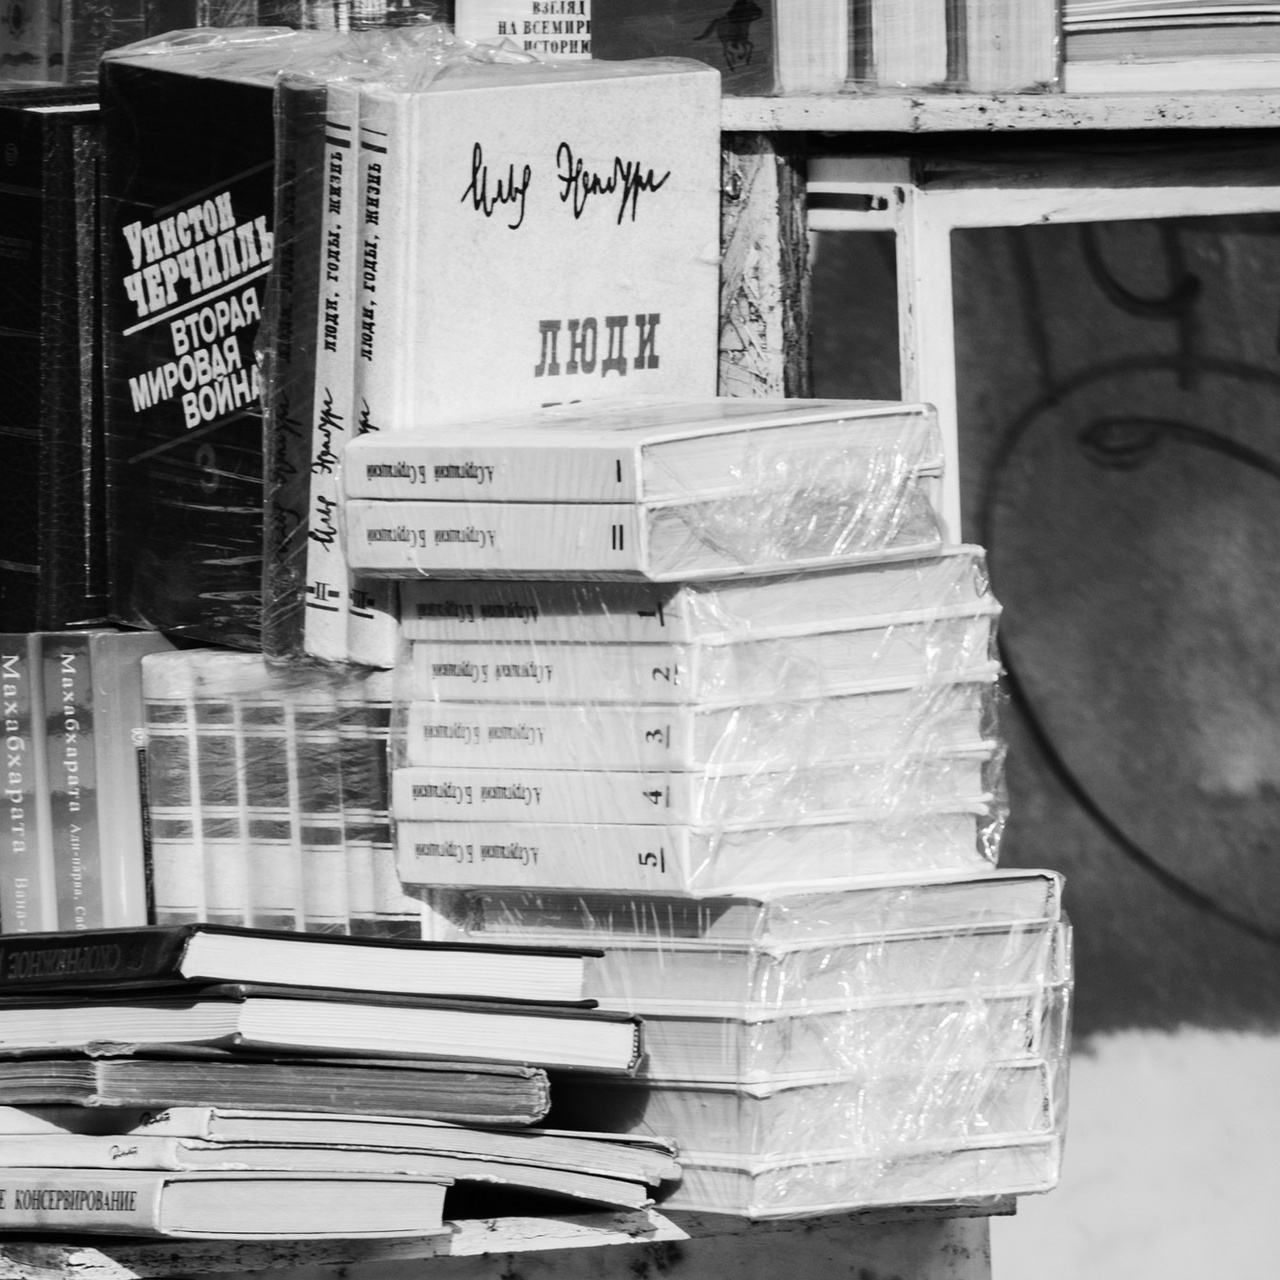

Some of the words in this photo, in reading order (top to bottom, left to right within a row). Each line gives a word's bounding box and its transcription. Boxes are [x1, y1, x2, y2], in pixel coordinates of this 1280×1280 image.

[498, 21, 518, 35] НА
[328, 151, 343, 215] ЖИЗНЬ
[365, 162, 382, 226] ЖИЗНЬ
[123, 215, 274, 318] ЧЕРЧИЛЛЬ
[170, 287, 262, 356] ВТОРАЯ
[535, 313, 660, 378] ЛЮДИ
[128, 335, 242, 413] МИРОВАЯ
[181, 363, 265, 429] ВОЙНА
[1, 654, 27, 853] Махабхарата
[60, 653, 82, 812] Махабхарата
[14, 1189, 138, 1211] КОНСЕРВИРОВАНИЕ
